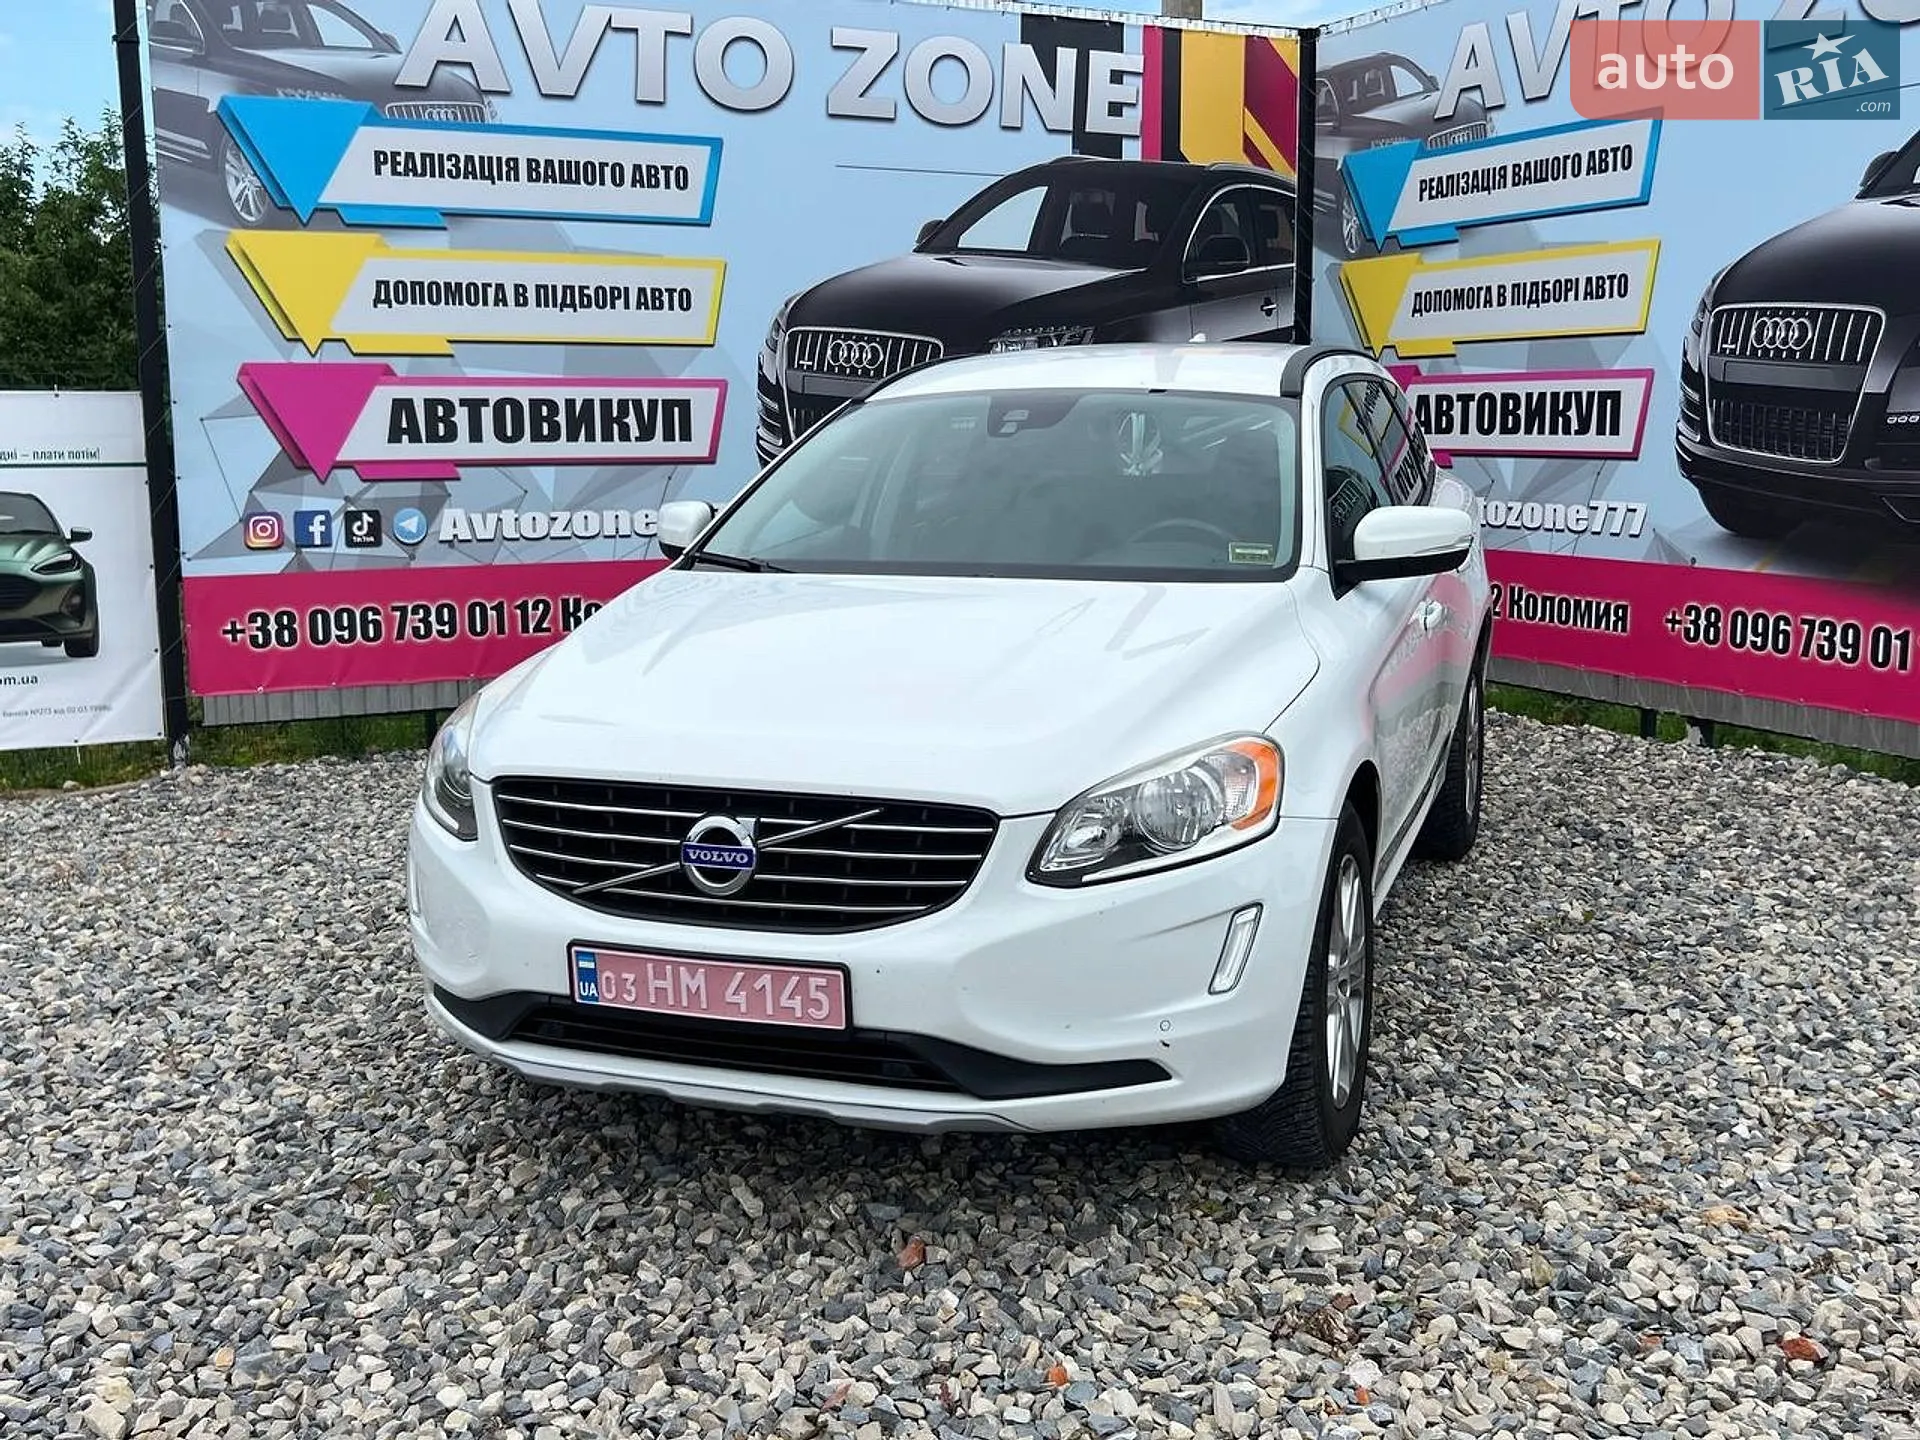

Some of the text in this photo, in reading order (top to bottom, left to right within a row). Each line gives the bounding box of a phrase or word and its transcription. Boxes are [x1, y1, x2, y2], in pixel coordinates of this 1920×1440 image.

[394, 0, 1145, 138] AVTO ZONE
[373, 149, 690, 191] РЕАЛІЗАЦІЯ ВАШОГО АВТО
[1418, 143, 1633, 202] РЕАЛІЗАЦІЯ ВАШОГО АВТО
[372, 279, 693, 312] ДОПОМОГА В ПІДБОРІ АВТО
[1411, 272, 1629, 318] ДОПОМОГА В ПІДБОРІ АВТО
[386, 396, 693, 444] АВТОВИКУП
[1415, 390, 1622, 437] АВТОВИКУП
[438, 506, 659, 543] Avtozone
[222, 609, 299, 650] +38
[308, 605, 383, 646] 096
[391, 601, 458, 641] 739
[467, 600, 506, 636] 01
[514, 598, 552, 635] 12
[1664, 603, 1722, 647] +38
[1729, 609, 1792, 656] 096
[1799, 617, 1862, 665] 739
[1870, 625, 1911, 672] 01
[685, 848, 749, 864] VOLVO
[579, 962, 830, 1020] UA 03 HM 4145
